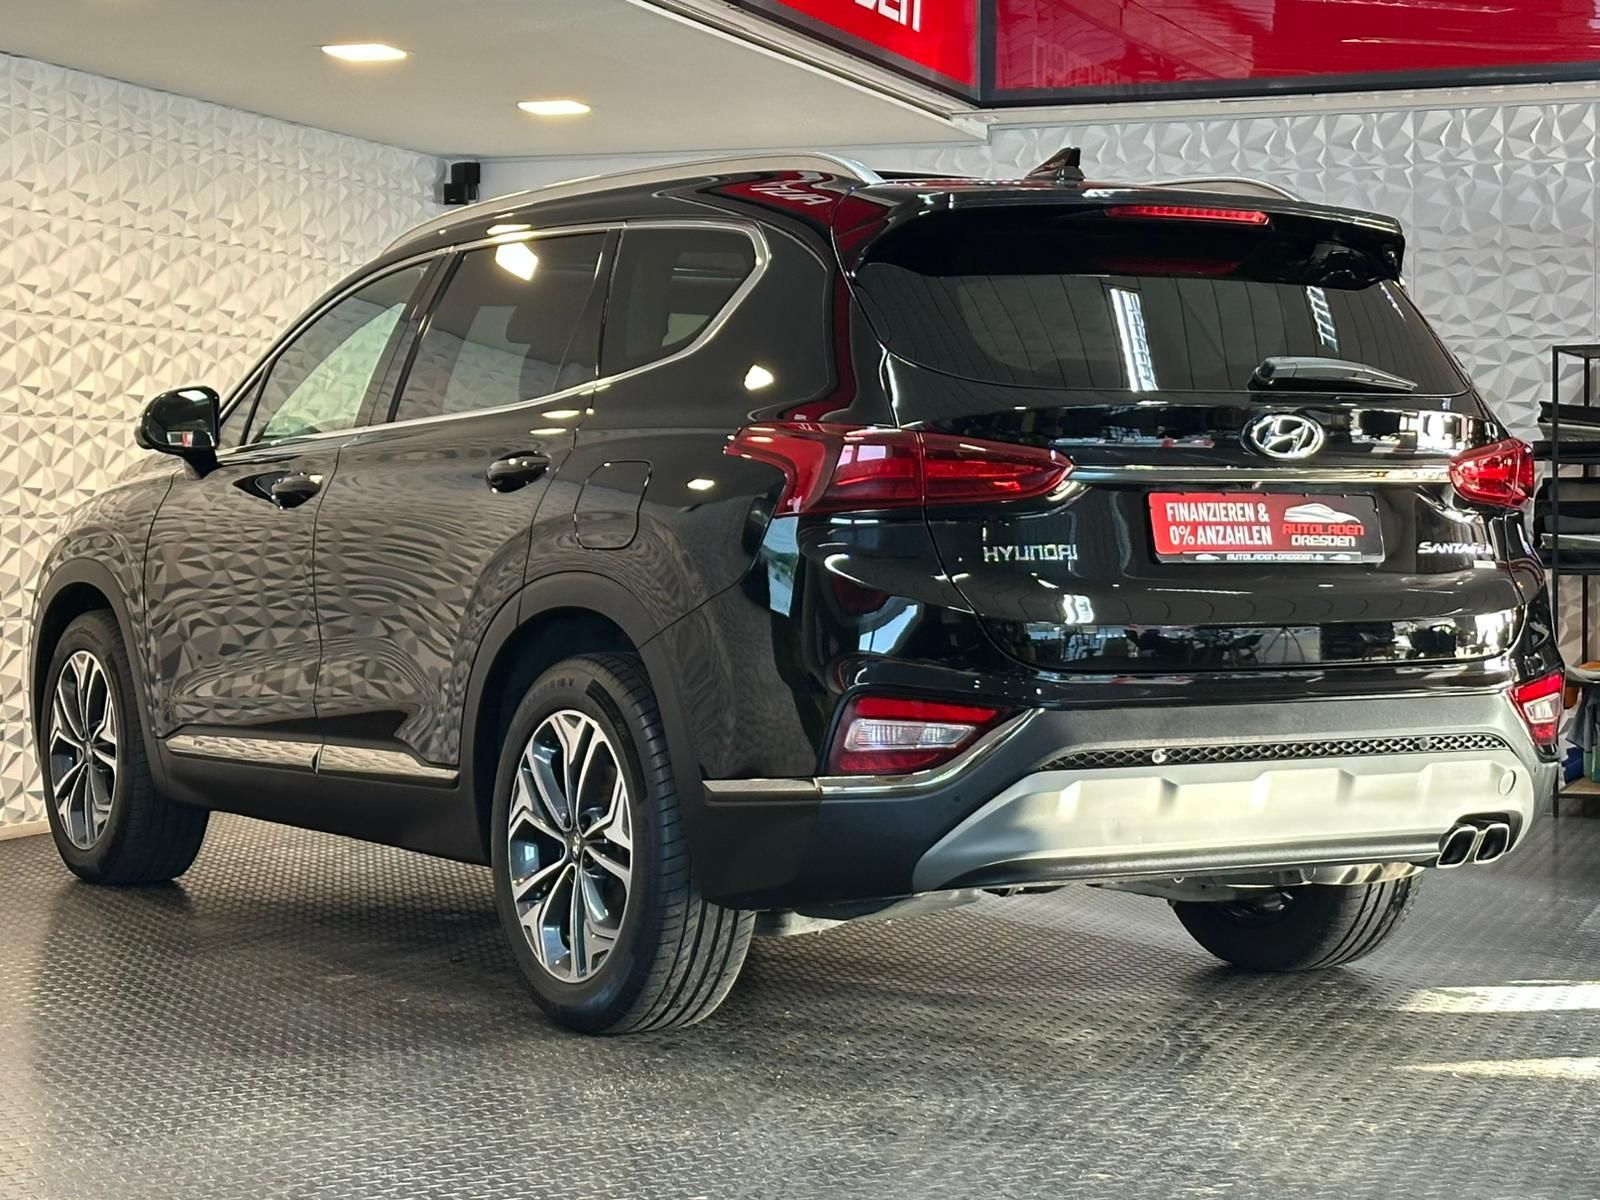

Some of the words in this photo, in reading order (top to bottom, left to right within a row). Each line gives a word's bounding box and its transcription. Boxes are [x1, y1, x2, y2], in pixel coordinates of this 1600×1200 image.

[1165, 502, 1255, 522] FINANZIEREN
[1257, 502, 1270, 522] &
[1169, 525, 1195, 545] 0%
[1197, 525, 1273, 545] ANZAHLEN
[1282, 523, 1365, 536] AUTOLADEN
[1291, 534, 1356, 547] DRESDEN
[983, 544, 1078, 562] HYUNDAI
